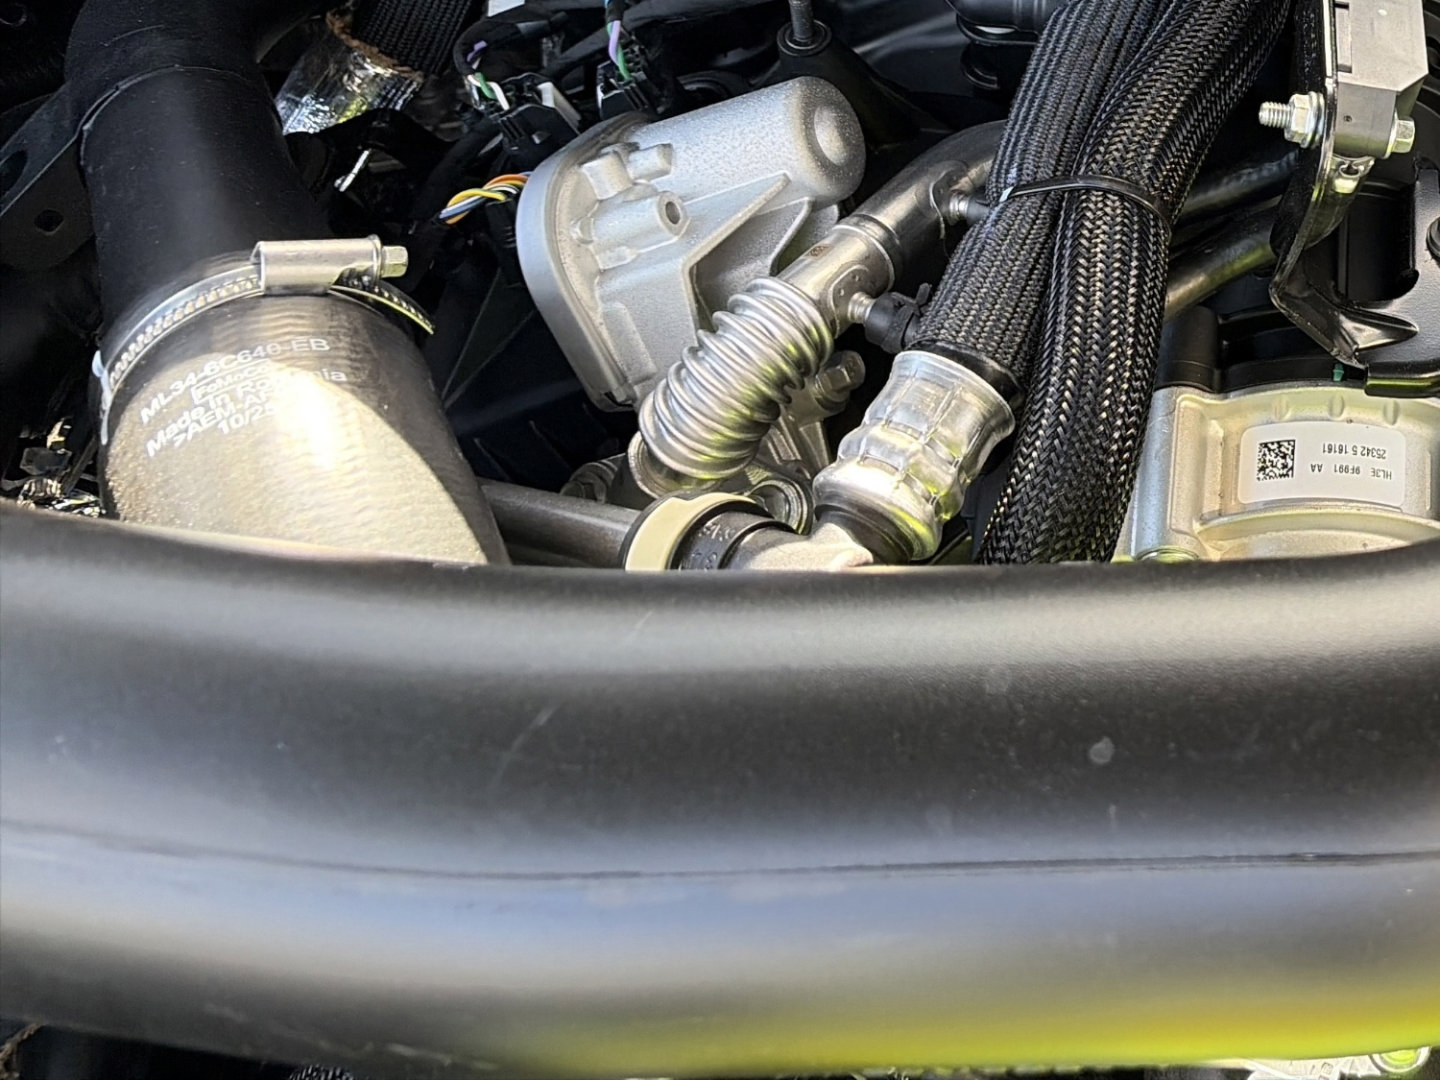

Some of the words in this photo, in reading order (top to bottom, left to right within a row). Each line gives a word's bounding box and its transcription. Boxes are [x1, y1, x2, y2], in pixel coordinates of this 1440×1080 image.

[141, 338, 331, 424] ML34-6C640-EB
[198, 364, 269, 399] FoMoCo
[145, 405, 207, 458] Made
[1351, 445, 1358, 456] 5
[1360, 445, 1386, 460] 25342
[1309, 463, 1323, 473] AA
[1371, 467, 1392, 480] HL3E
